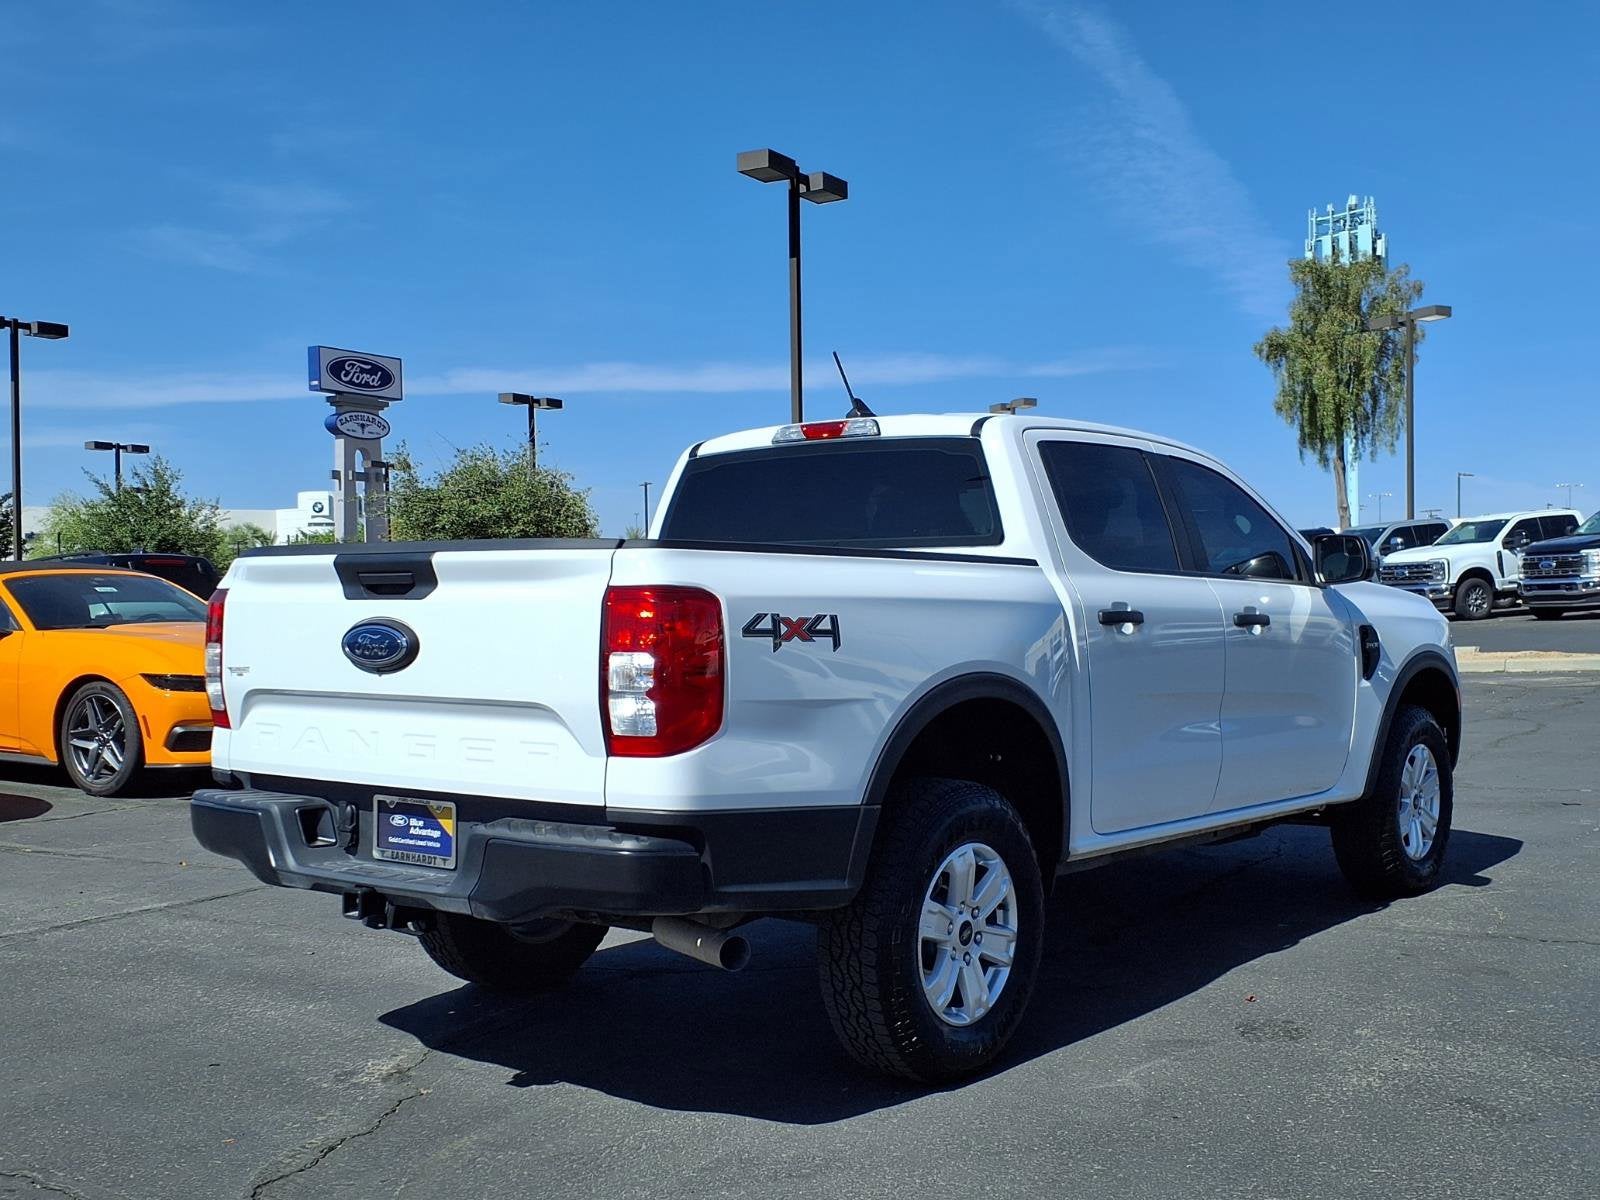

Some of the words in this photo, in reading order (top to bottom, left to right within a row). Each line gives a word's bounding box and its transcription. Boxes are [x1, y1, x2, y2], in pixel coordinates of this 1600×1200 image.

[340, 360, 382, 387] Ford
[339, 414, 387, 432] EARNHARDT
[354, 633, 390, 656] Ford
[253, 721, 559, 768] RANGER
[409, 818, 424, 826] Blue
[409, 827, 441, 838] Advantage
[390, 850, 438, 865] EARNHARDT
